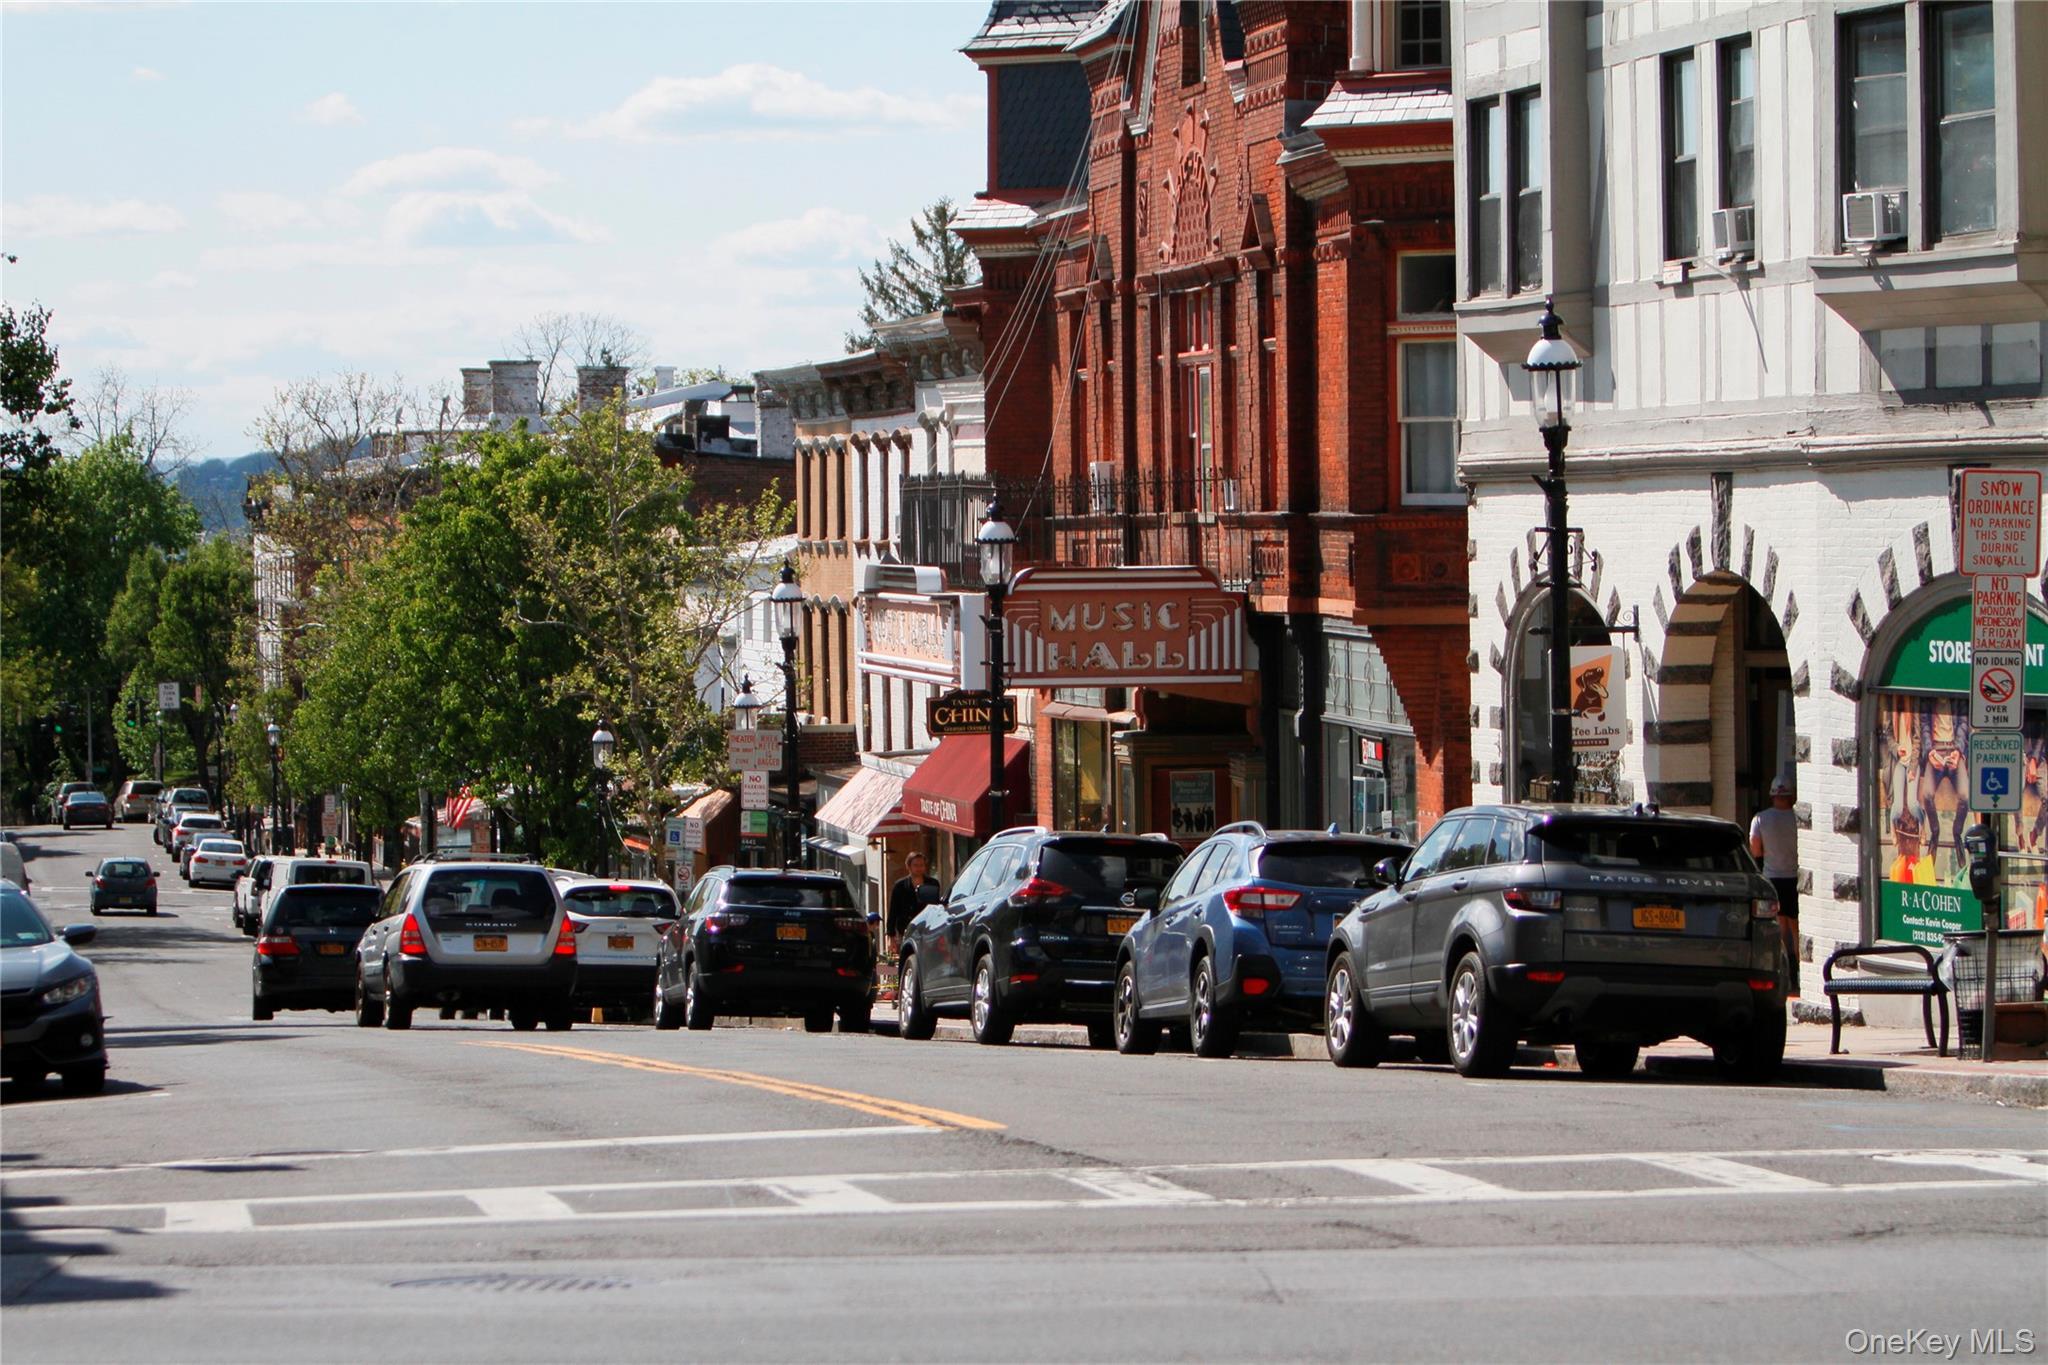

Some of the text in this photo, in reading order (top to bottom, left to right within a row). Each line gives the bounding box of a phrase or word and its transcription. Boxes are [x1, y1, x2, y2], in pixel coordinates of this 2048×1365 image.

[1981, 481, 2022, 496] SNOW
[1968, 500, 2034, 515] ORDINANCE
[1970, 519, 2031, 528] NO PARKING
[1975, 530, 2026, 540] THIS SIDE
[1981, 543, 2018, 553] DURING
[1972, 555, 2027, 566] SNOWFALL
[1992, 577, 2008, 590] NO
[1976, 592, 2021, 606] PARKING
[1050, 602, 1180, 632] MUSIC
[1980, 606, 2016, 617] MONDAY
[1976, 617, 2023, 627] WEDNESDAY
[1982, 628, 2018, 638] FRIDAY
[1976, 639, 2021, 648] 3AM-6AM
[1048, 641, 1185, 670] HALL
[1928, 640, 2044, 666] STORE NT
[1976, 657, 2020, 666] NO IDLING
[1984, 715, 2008, 723] 3 MIN
[1594, 726, 1620, 736] Labs
[1973, 740, 2020, 750] RESERVED
[1976, 754, 2016, 763] PARKING
[920, 798, 957, 822] TASTE OF CHINA
[1590, 875, 1725, 887] RANGE ROVER
[1902, 914, 1962, 932] Contact: Kevin Cooper
[1912, 930, 1926, 941] (212)
